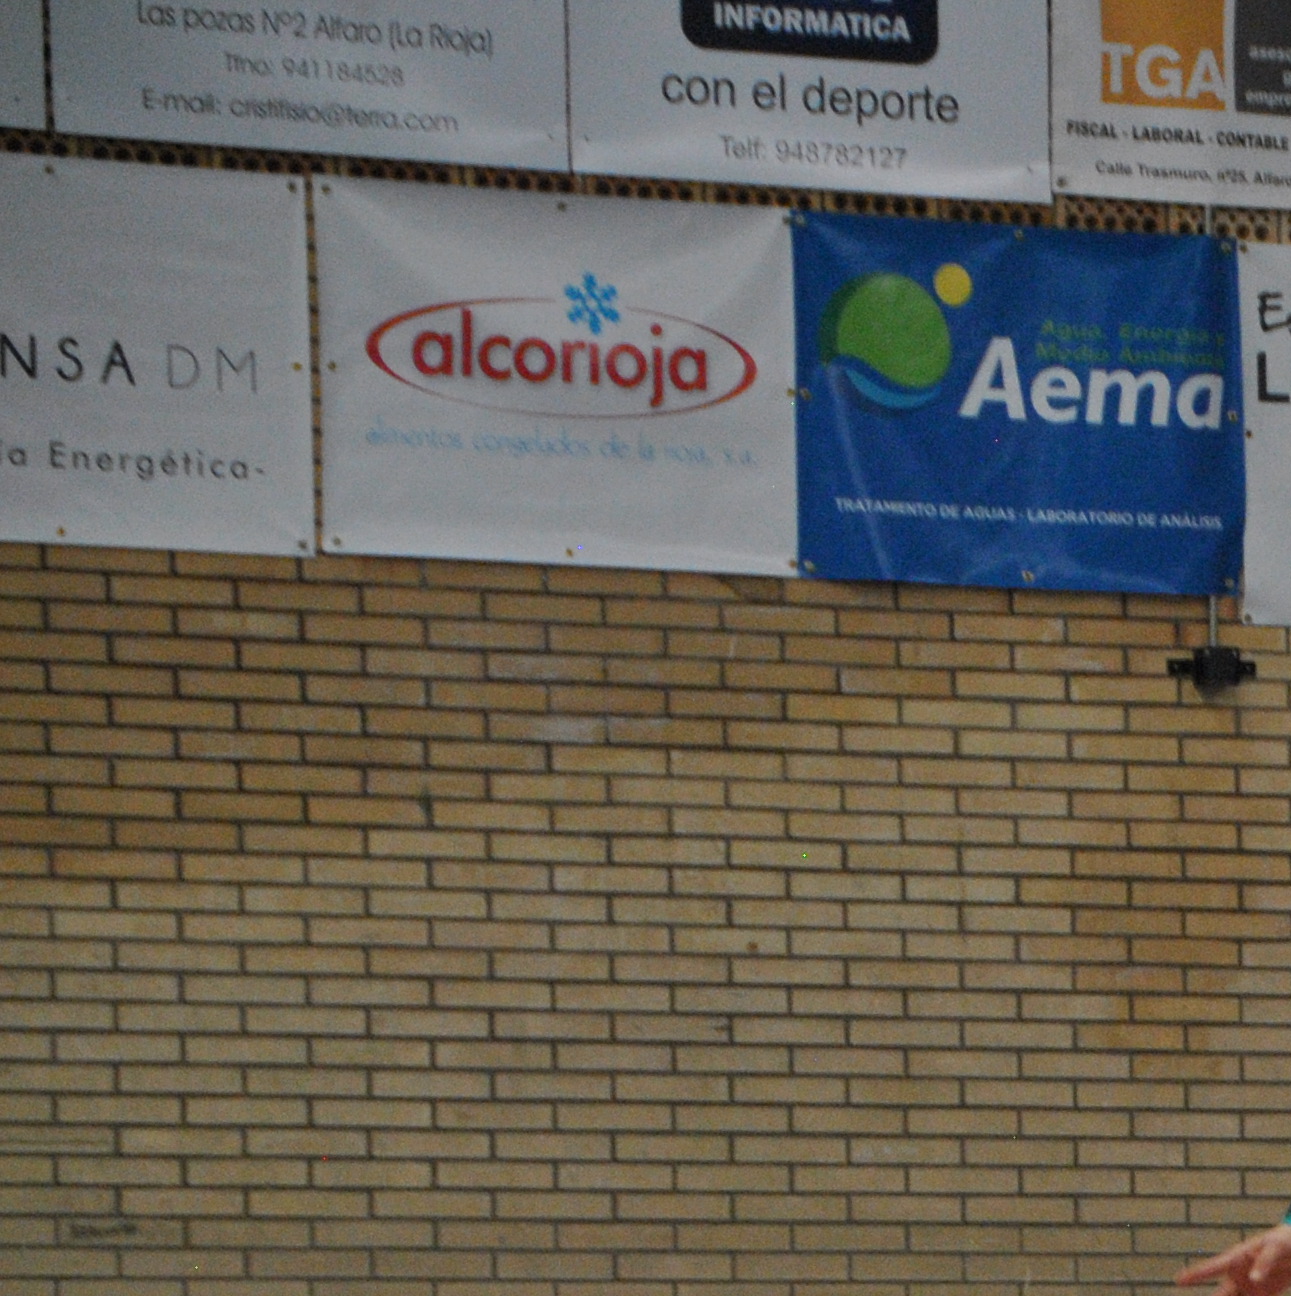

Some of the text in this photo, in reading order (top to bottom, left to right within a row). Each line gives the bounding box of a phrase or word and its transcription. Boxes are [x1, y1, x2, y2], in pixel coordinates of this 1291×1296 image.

[137, 0, 176, 26] Las
[314, 14, 382, 44] Alfaro
[388, 21, 423, 51] (La
[429, 22, 494, 60] Rioja)
[713, 2, 912, 44] INFORMATICA
[1100, 42, 1226, 100] TGA
[661, 72, 960, 126] con el deporte
[774, 139, 908, 170] 948782127
[1066, 119, 1119, 140] FISCAL
[1132, 124, 1205, 145] LABORAL
[1216, 130, 1290, 151] CONTABLE
[1095, 160, 1133, 176] Calle
[0, 332, 259, 396] NSA DM
[958, 336, 1224, 430] Aema
[939, 503, 961, 520] DE
[963, 505, 1016, 522] AGUAS
[1026, 508, 1135, 526] LABORATORIO
[1137, 511, 1157, 528] DE
